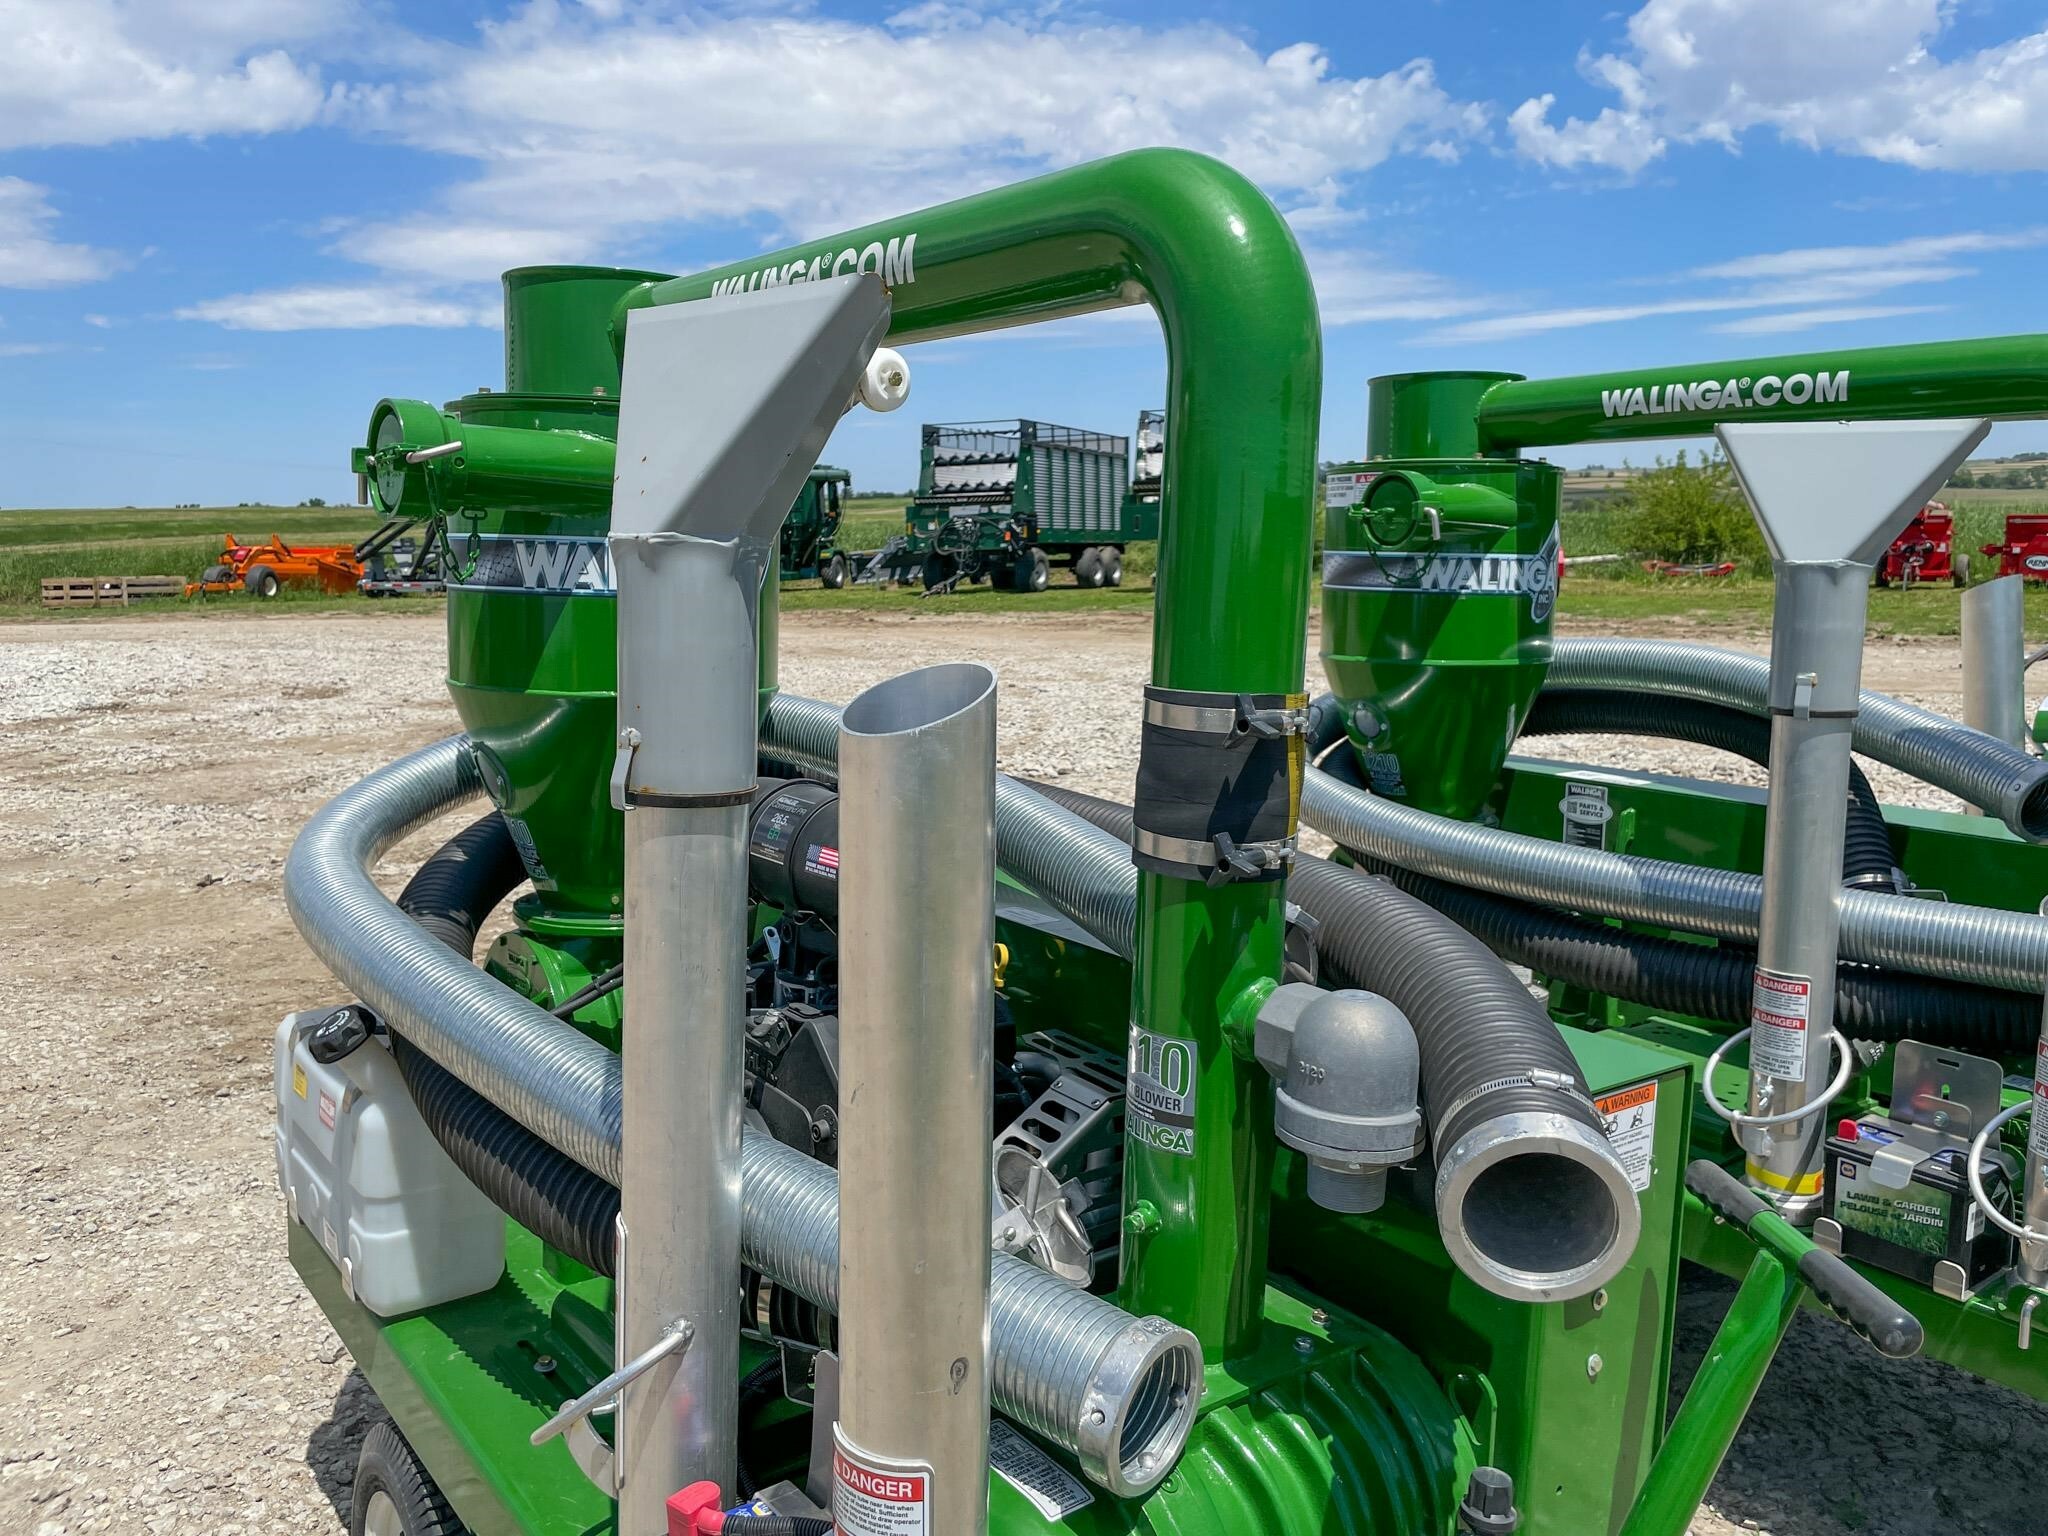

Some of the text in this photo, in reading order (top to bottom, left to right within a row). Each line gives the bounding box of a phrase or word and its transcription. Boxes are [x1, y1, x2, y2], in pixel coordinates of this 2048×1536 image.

[1763, 979, 1802, 994] DANGER
[1761, 1012, 1800, 1028] DANGER
[1134, 1085, 1181, 1113] BLOWER
[1611, 1088, 1650, 1110] WARNING
[1840, 1201, 1888, 1217] PELOUSE
[1902, 1213, 1944, 1227] JARDIN
[1893, 1200, 1941, 1215] GARDEN
[842, 1462, 912, 1498] DANGER
[878, 1516, 893, 1524] draw
[879, 1509, 909, 1518] Sufficient
